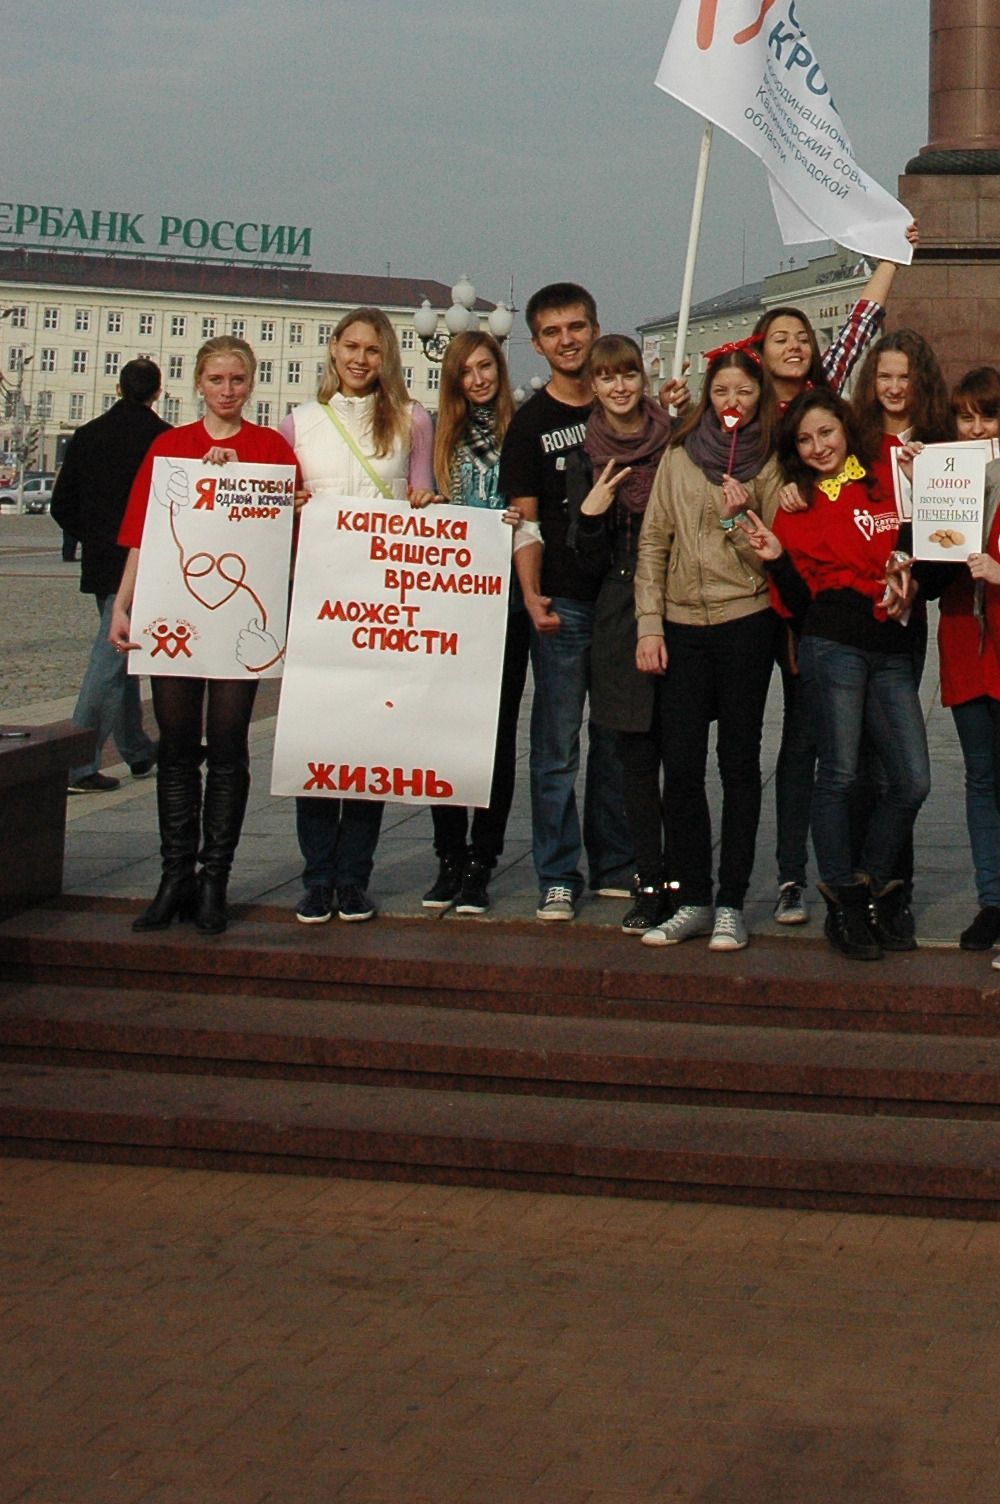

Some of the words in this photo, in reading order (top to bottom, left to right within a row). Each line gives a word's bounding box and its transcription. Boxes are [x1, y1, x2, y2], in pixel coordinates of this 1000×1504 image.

[768, 20, 839, 115] КРО
[159, 215, 312, 256] РОССИИ
[541, 423, 587, 453] ROWIN
[944, 457, 956, 472] Я
[192, 477, 217, 510] Я
[927, 478, 971, 490] ДОНОР
[227, 506, 281, 522] ДОНОР
[917, 508, 979, 521] ПЕЧЕНЬКИ
[920, 496, 956, 508] потому
[958, 497, 977, 505] что
[336, 510, 468, 541] капелька
[370, 535, 472, 567] Вашего
[384, 568, 502, 604] времени
[317, 600, 420, 627] может
[352, 626, 458, 655] спасти
